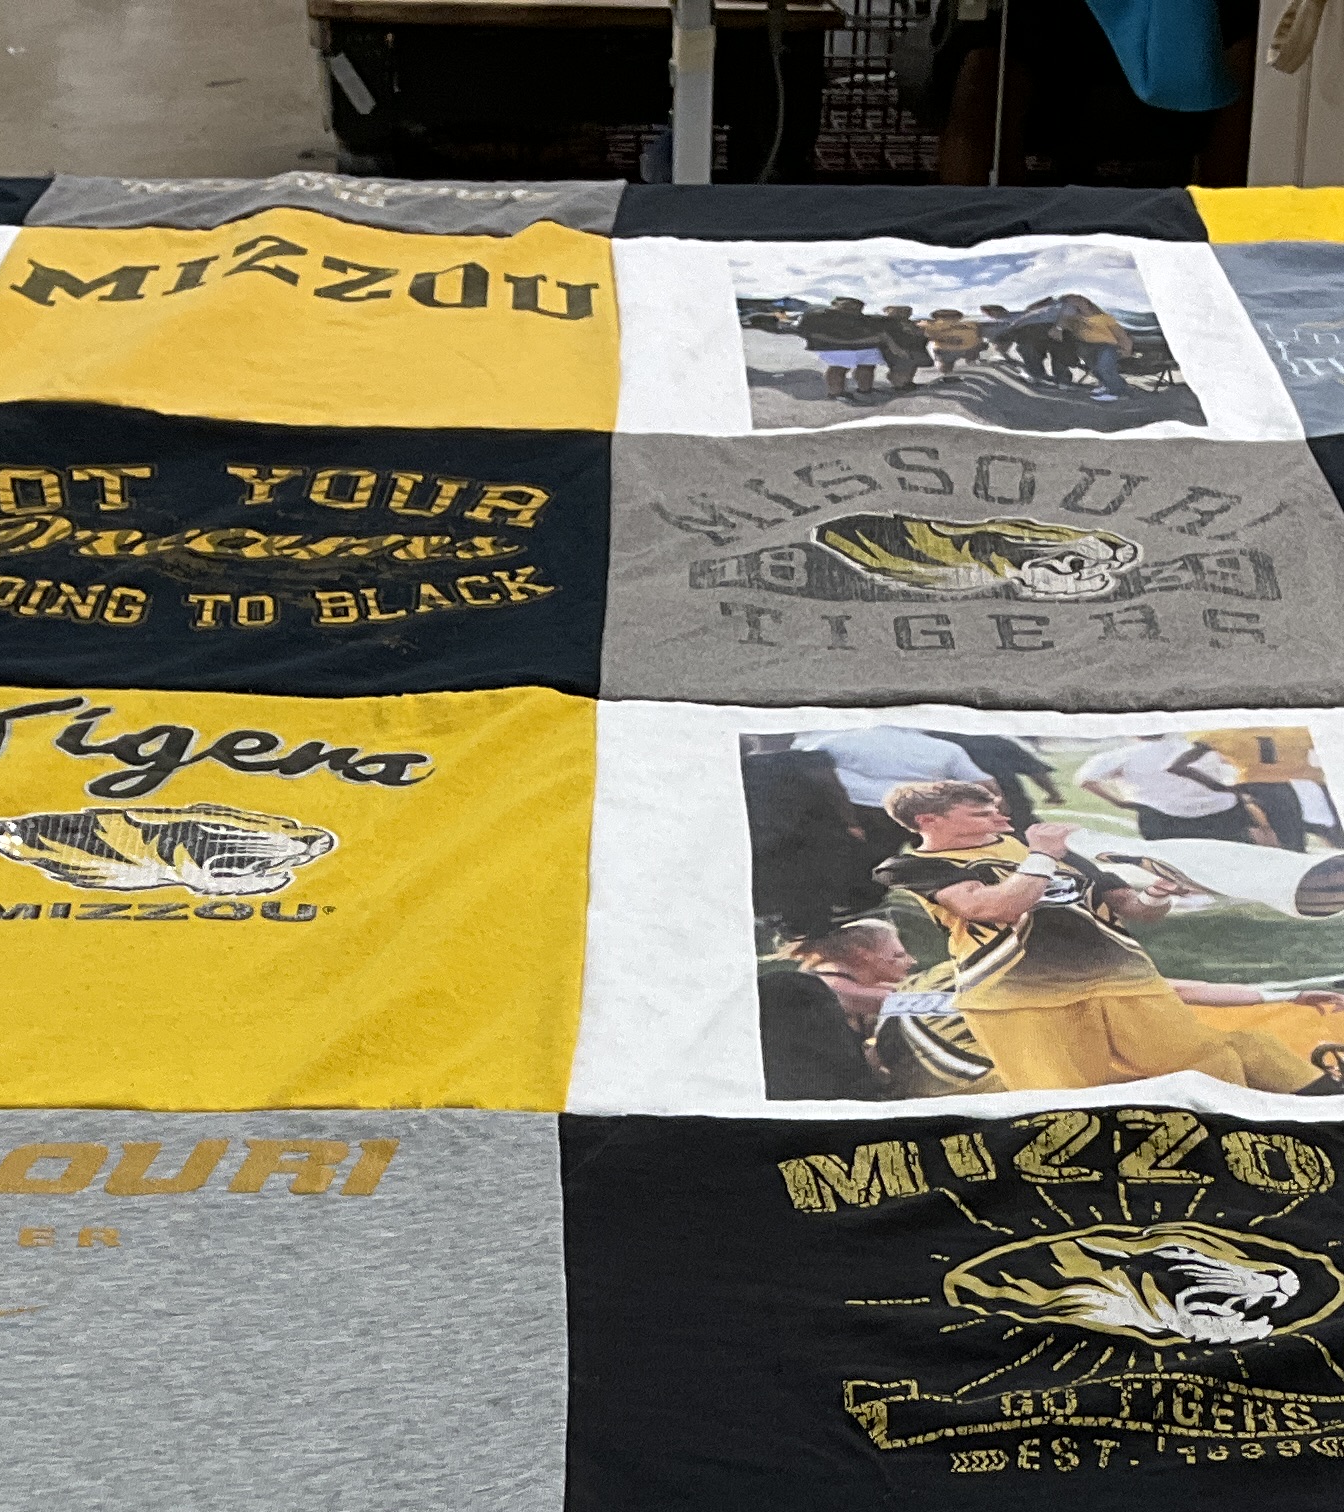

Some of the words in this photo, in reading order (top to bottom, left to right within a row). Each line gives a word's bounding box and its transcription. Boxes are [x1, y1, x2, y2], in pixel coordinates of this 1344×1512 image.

[10, 234, 599, 321] MIZZOU
[226, 465, 551, 528] YOUR
[187, 594, 275, 628] TO
[314, 565, 556, 625] BLACK
[718, 602, 1278, 652] TIGERS
[1000, 1388, 1078, 1419] GO
[1016, 1437, 1141, 1472] EST.
